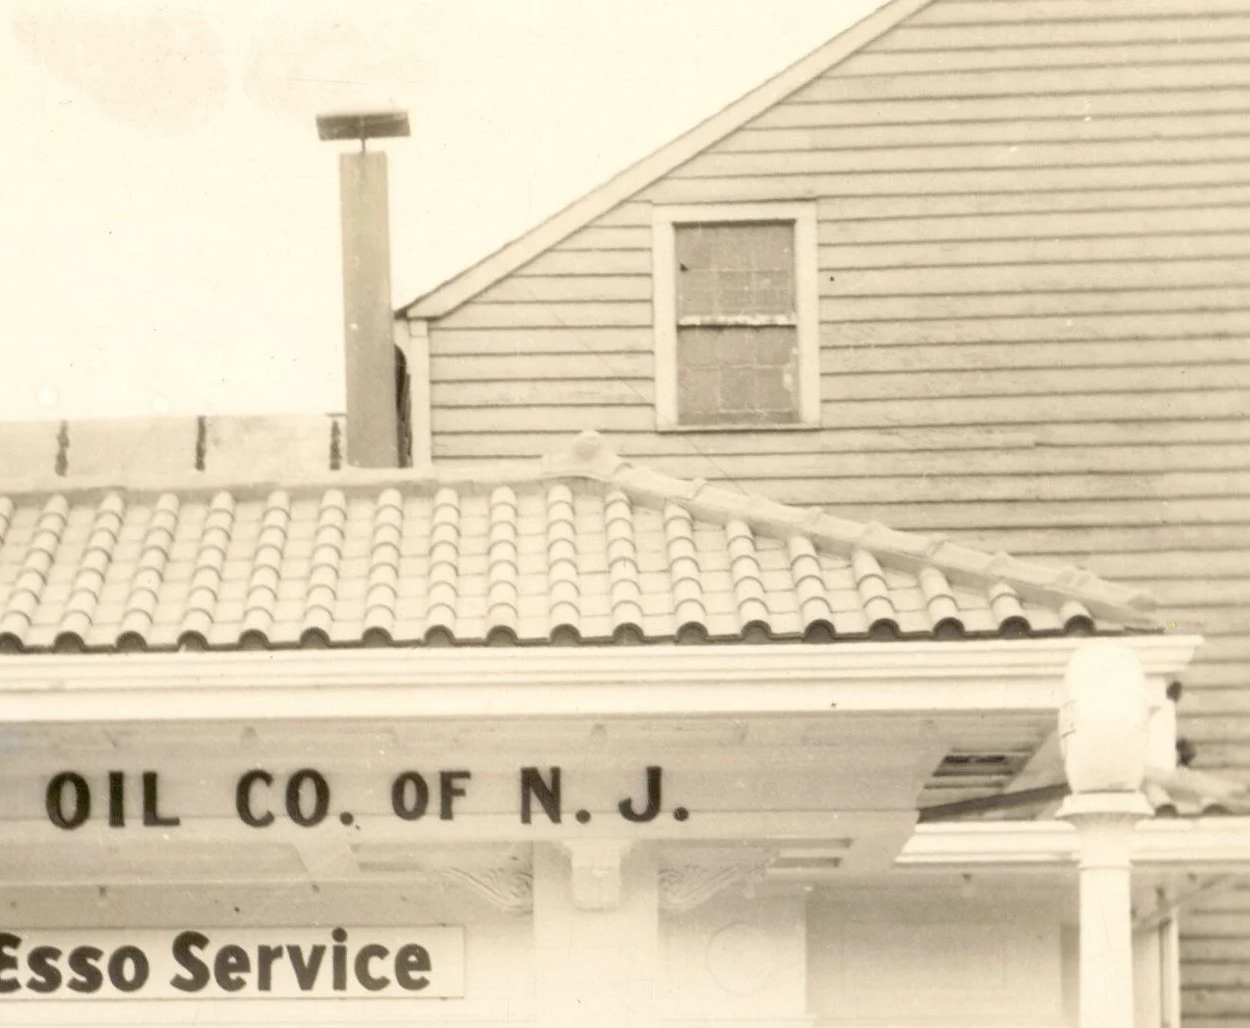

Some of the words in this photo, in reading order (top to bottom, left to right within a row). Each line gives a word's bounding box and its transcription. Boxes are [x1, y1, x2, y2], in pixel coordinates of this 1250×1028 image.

[47, 770, 180, 829] OIL
[236, 767, 354, 828] CO.
[391, 770, 471, 820] OF
[520, 765, 591, 824] N.
[617, 765, 690, 823] J.
[169, 927, 432, 993] Service
